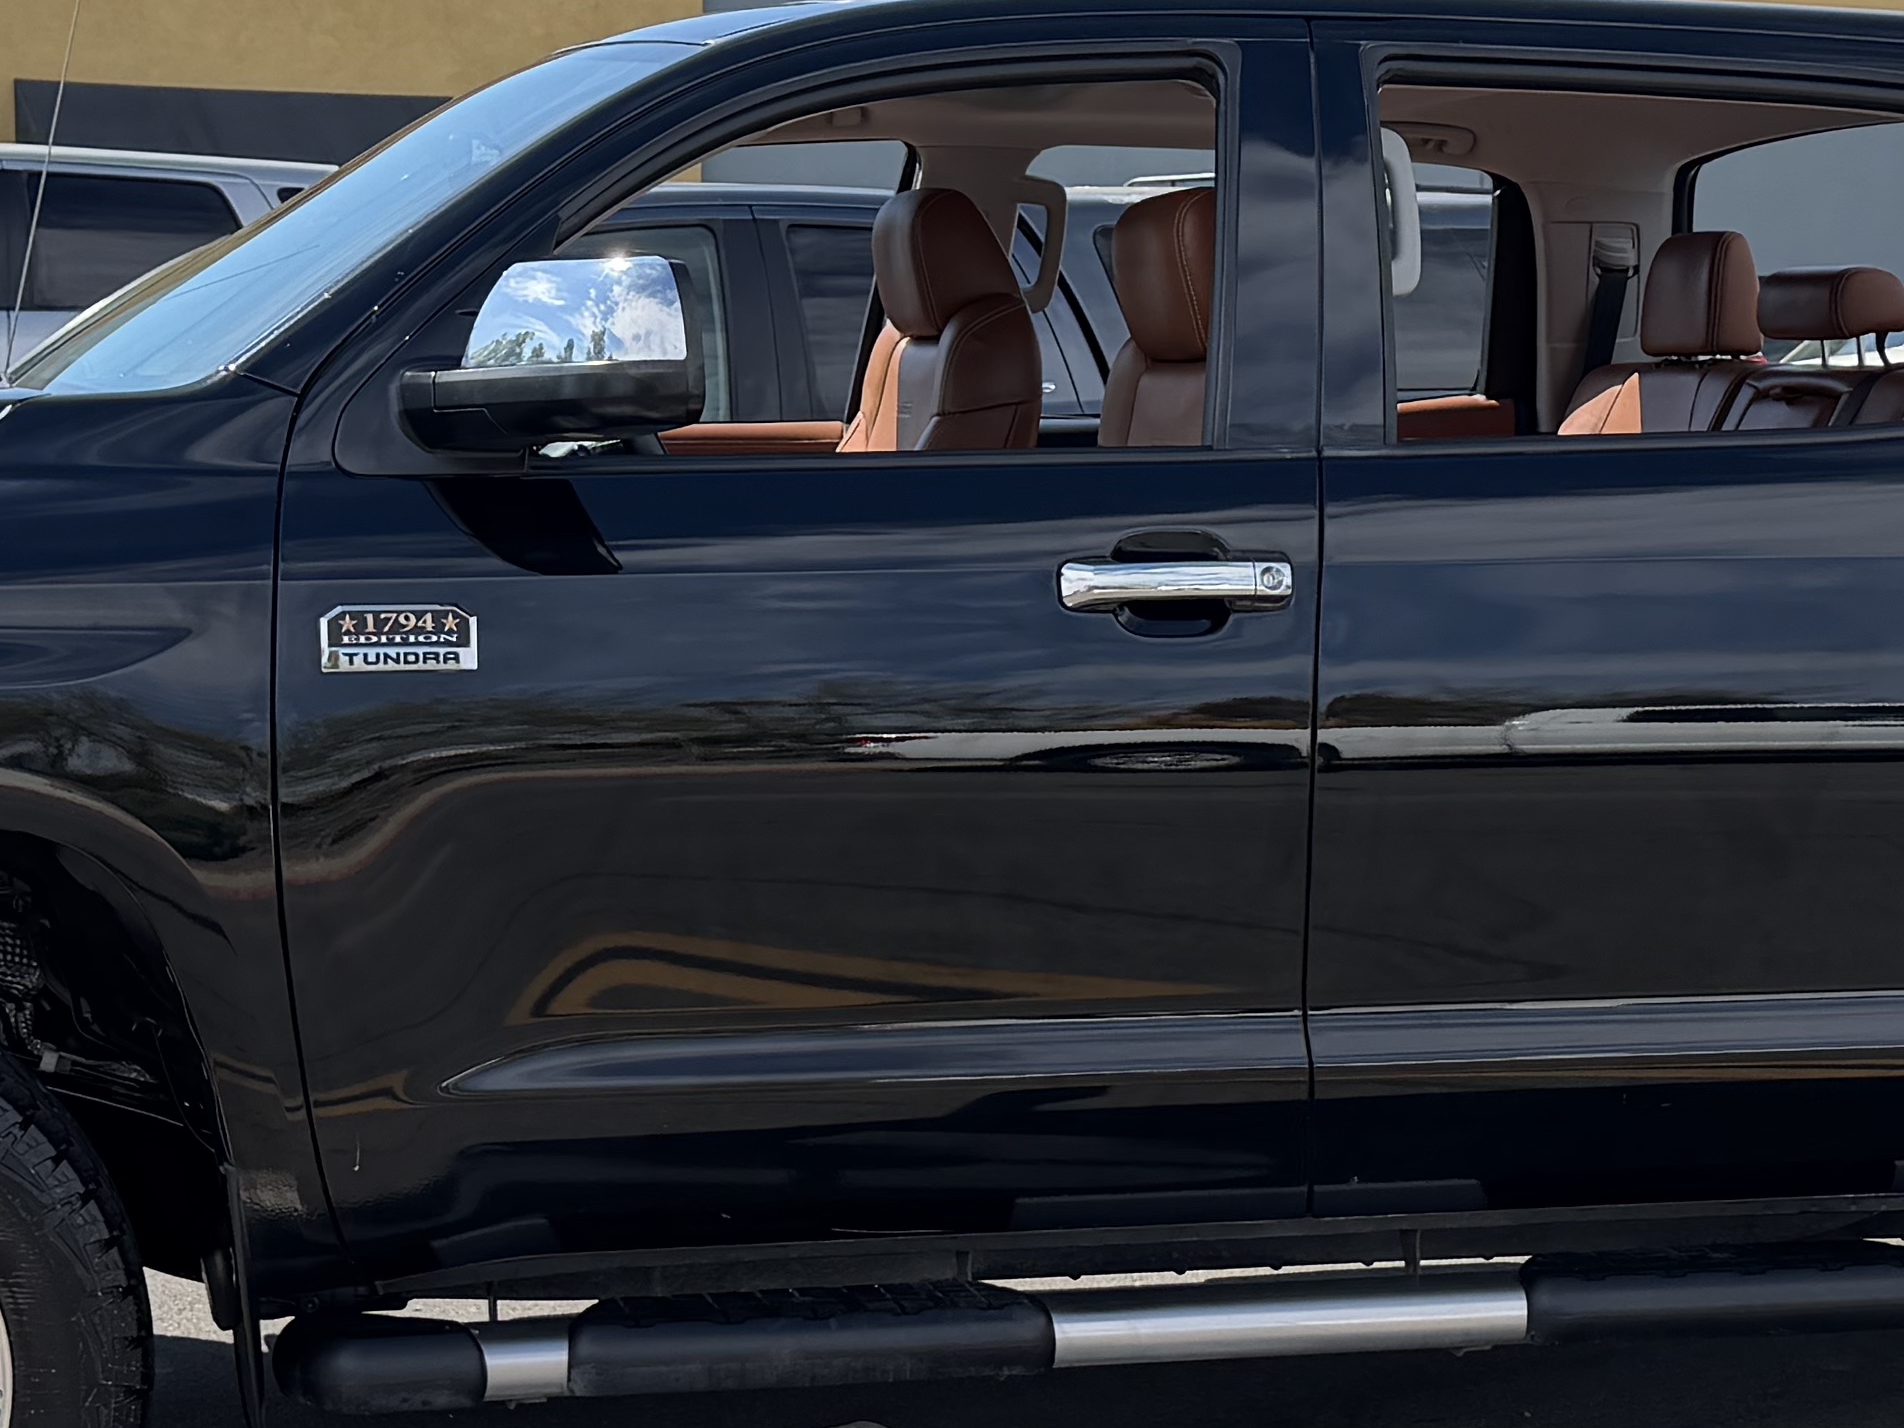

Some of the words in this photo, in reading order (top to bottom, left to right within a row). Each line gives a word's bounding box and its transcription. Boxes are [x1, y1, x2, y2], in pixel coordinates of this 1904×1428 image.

[363, 612, 436, 633] 1794
[340, 633, 459, 645] EDITION
[341, 651, 460, 666] TUNDRA
